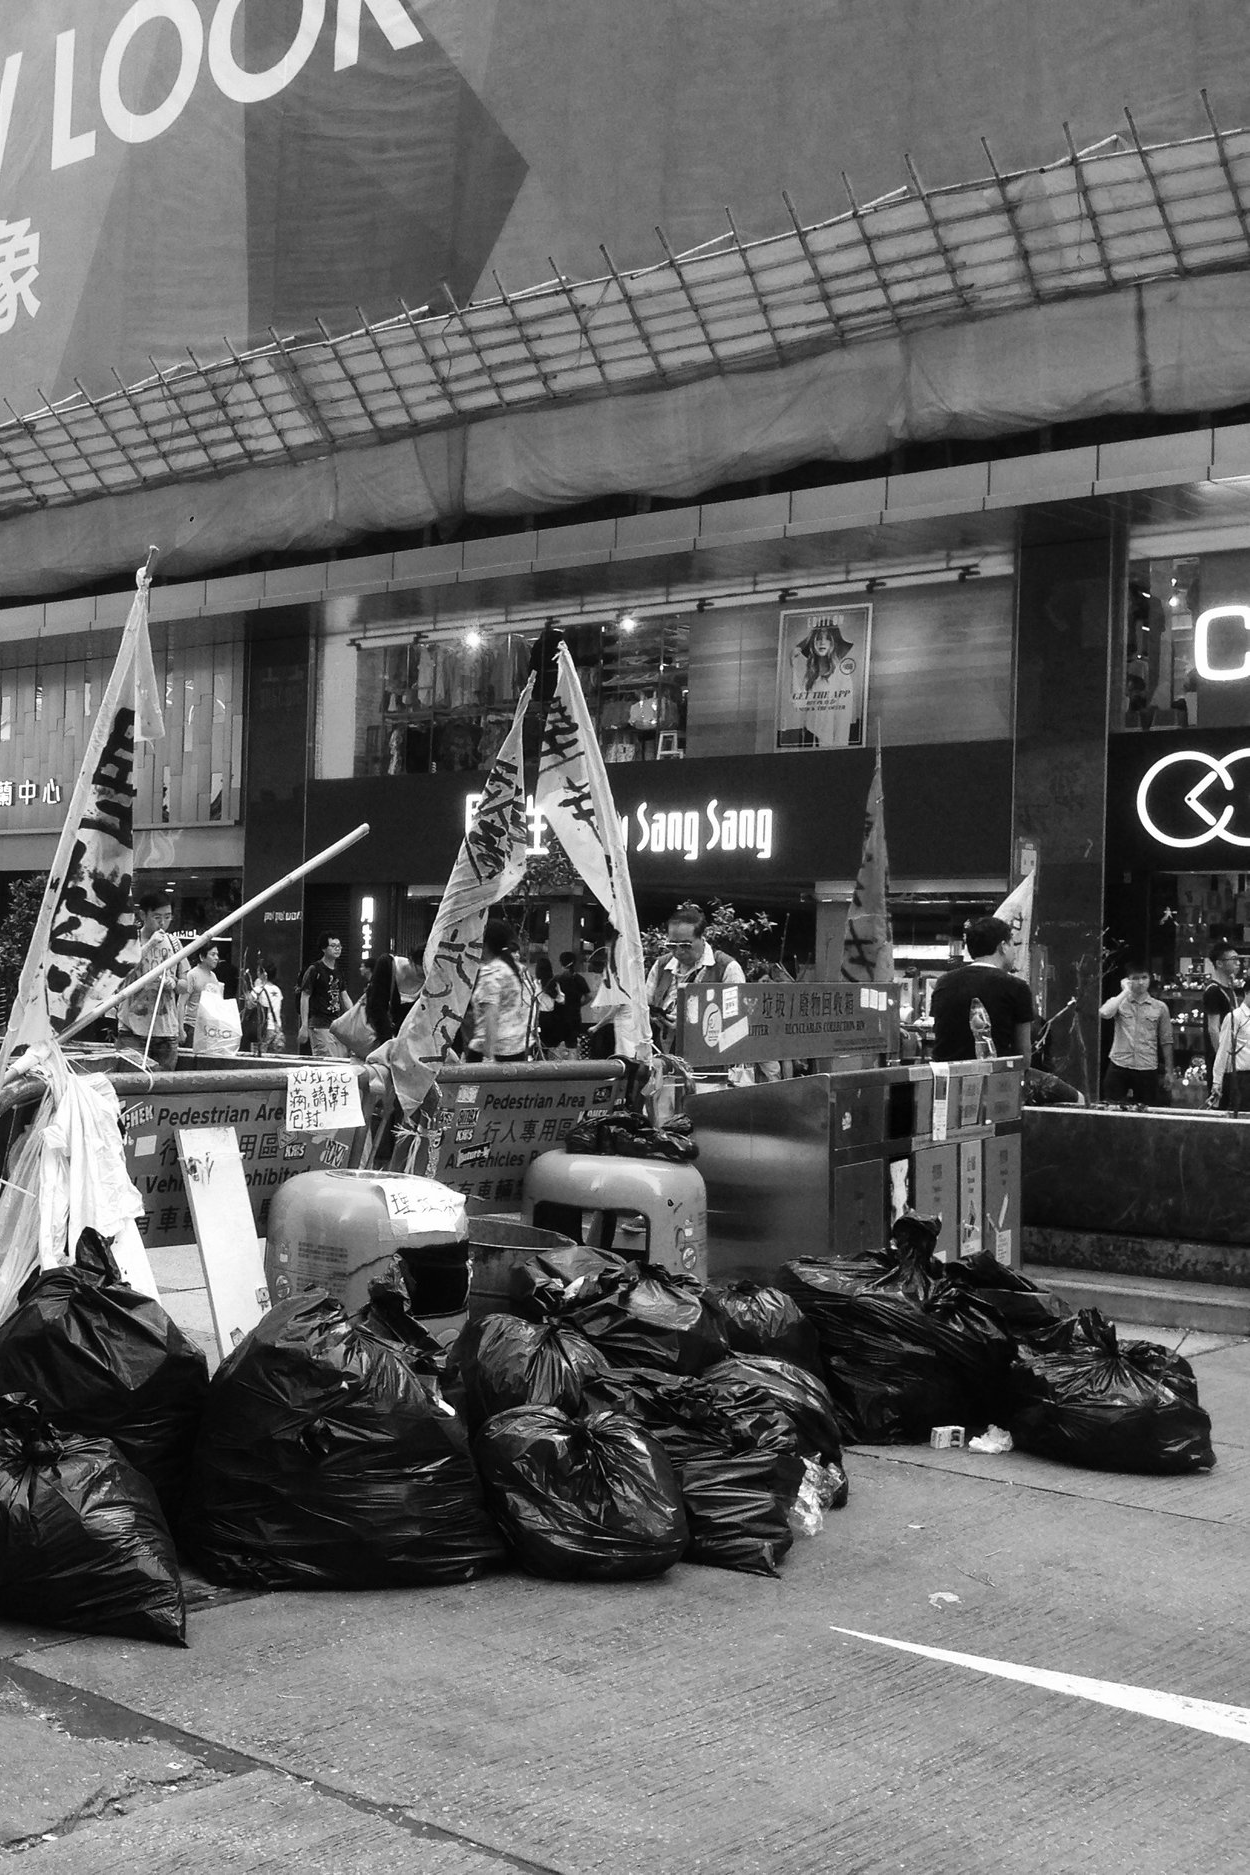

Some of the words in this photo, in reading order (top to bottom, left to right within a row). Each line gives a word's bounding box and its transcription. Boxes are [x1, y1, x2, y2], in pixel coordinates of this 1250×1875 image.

[636, 802, 700, 860] Sang
[706, 799, 773, 859] Sang
[484, 1092, 554, 1110] Pedestrian
[556, 1091, 586, 1108] Area
[157, 1105, 250, 1126] Pedestrian
[469, 1150, 525, 1169] ehicles
